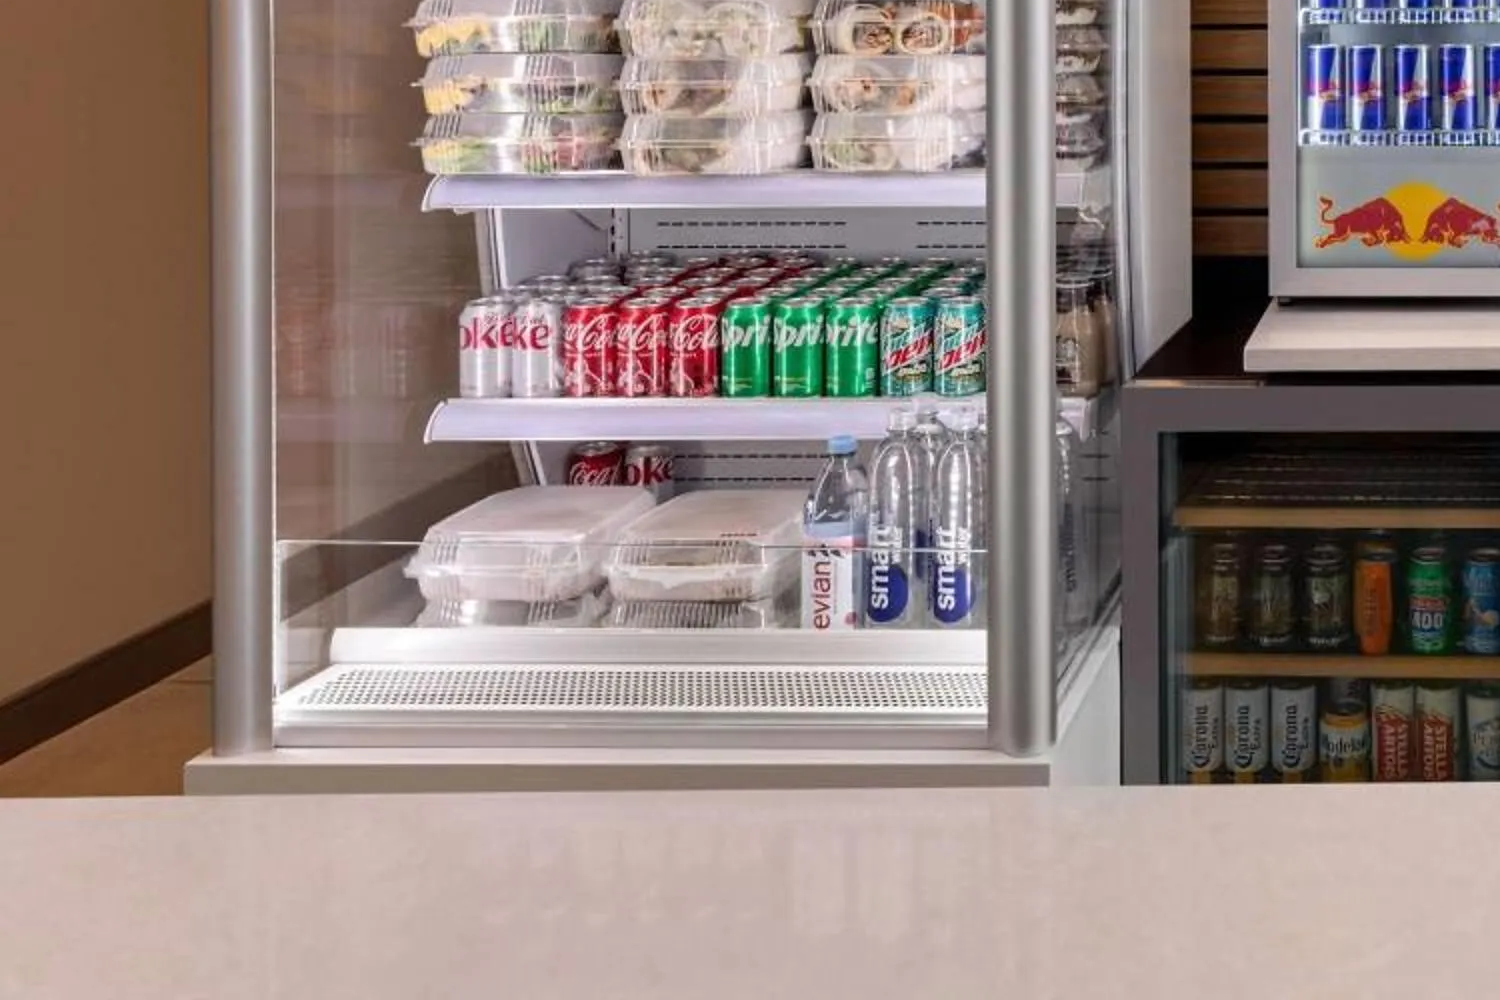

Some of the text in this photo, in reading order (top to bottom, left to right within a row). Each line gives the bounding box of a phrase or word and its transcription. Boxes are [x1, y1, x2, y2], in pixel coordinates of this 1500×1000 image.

[722, 314, 771, 352] Spri
[774, 314, 824, 352] Spri
[826, 316, 878, 347] rite
[871, 513, 889, 610] smart
[936, 525, 957, 611] smart
[811, 560, 832, 630] evian
[1191, 705, 1209, 768] Corona
[1233, 705, 1252, 768] Corona
[1281, 704, 1300, 768] Corona
